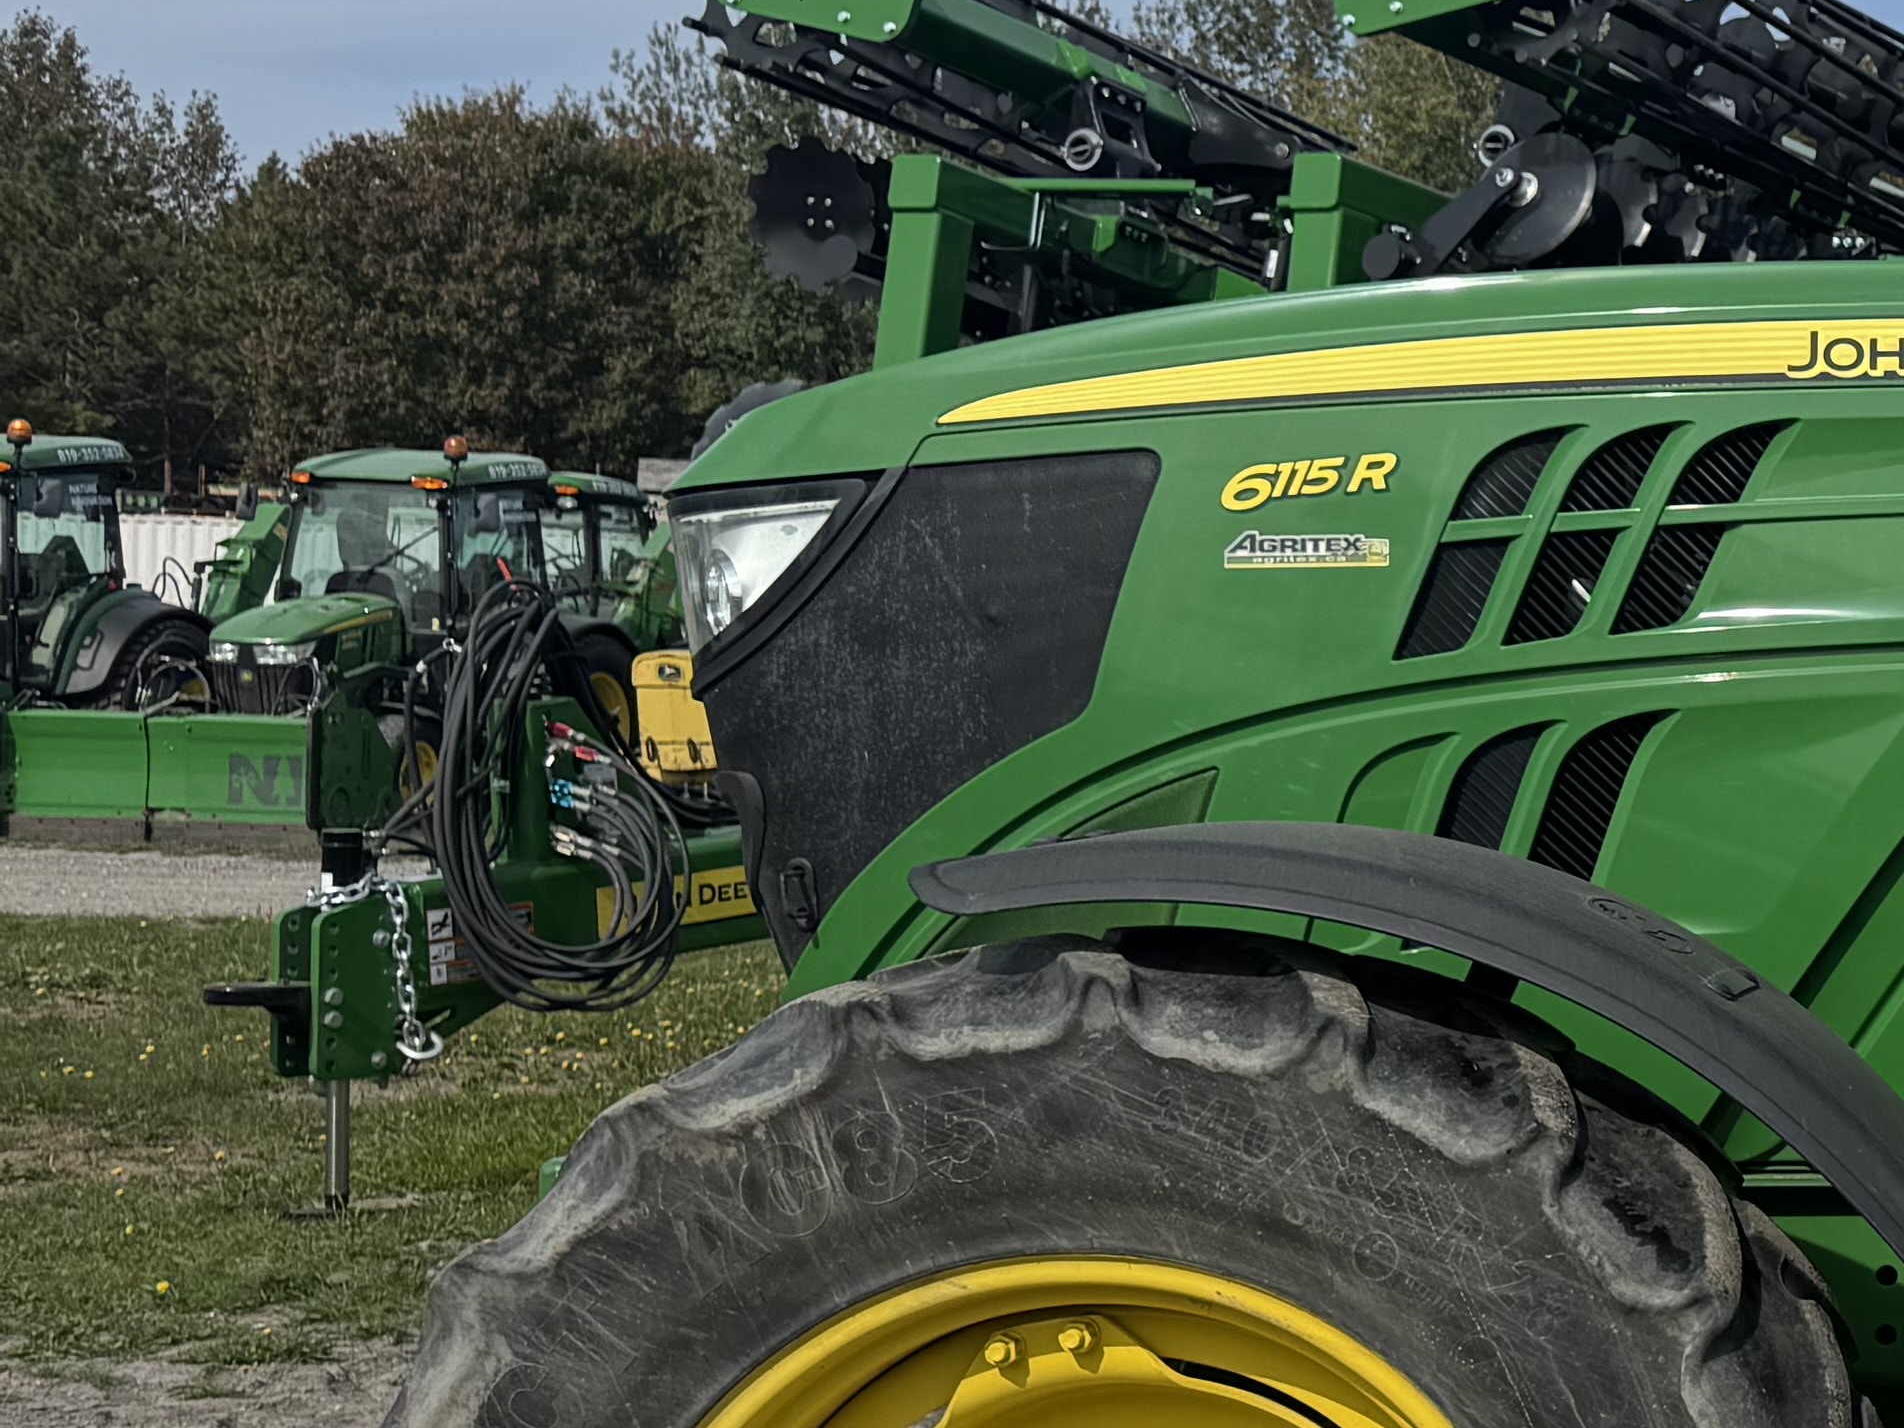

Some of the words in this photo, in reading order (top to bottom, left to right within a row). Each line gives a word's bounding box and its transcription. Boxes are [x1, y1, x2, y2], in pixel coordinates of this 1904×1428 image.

[1221, 456, 1346, 512] 6115
[1347, 452, 1398, 494] R
[1227, 533, 1364, 555] AGRITEX
[699, 881, 748, 905] DEE
